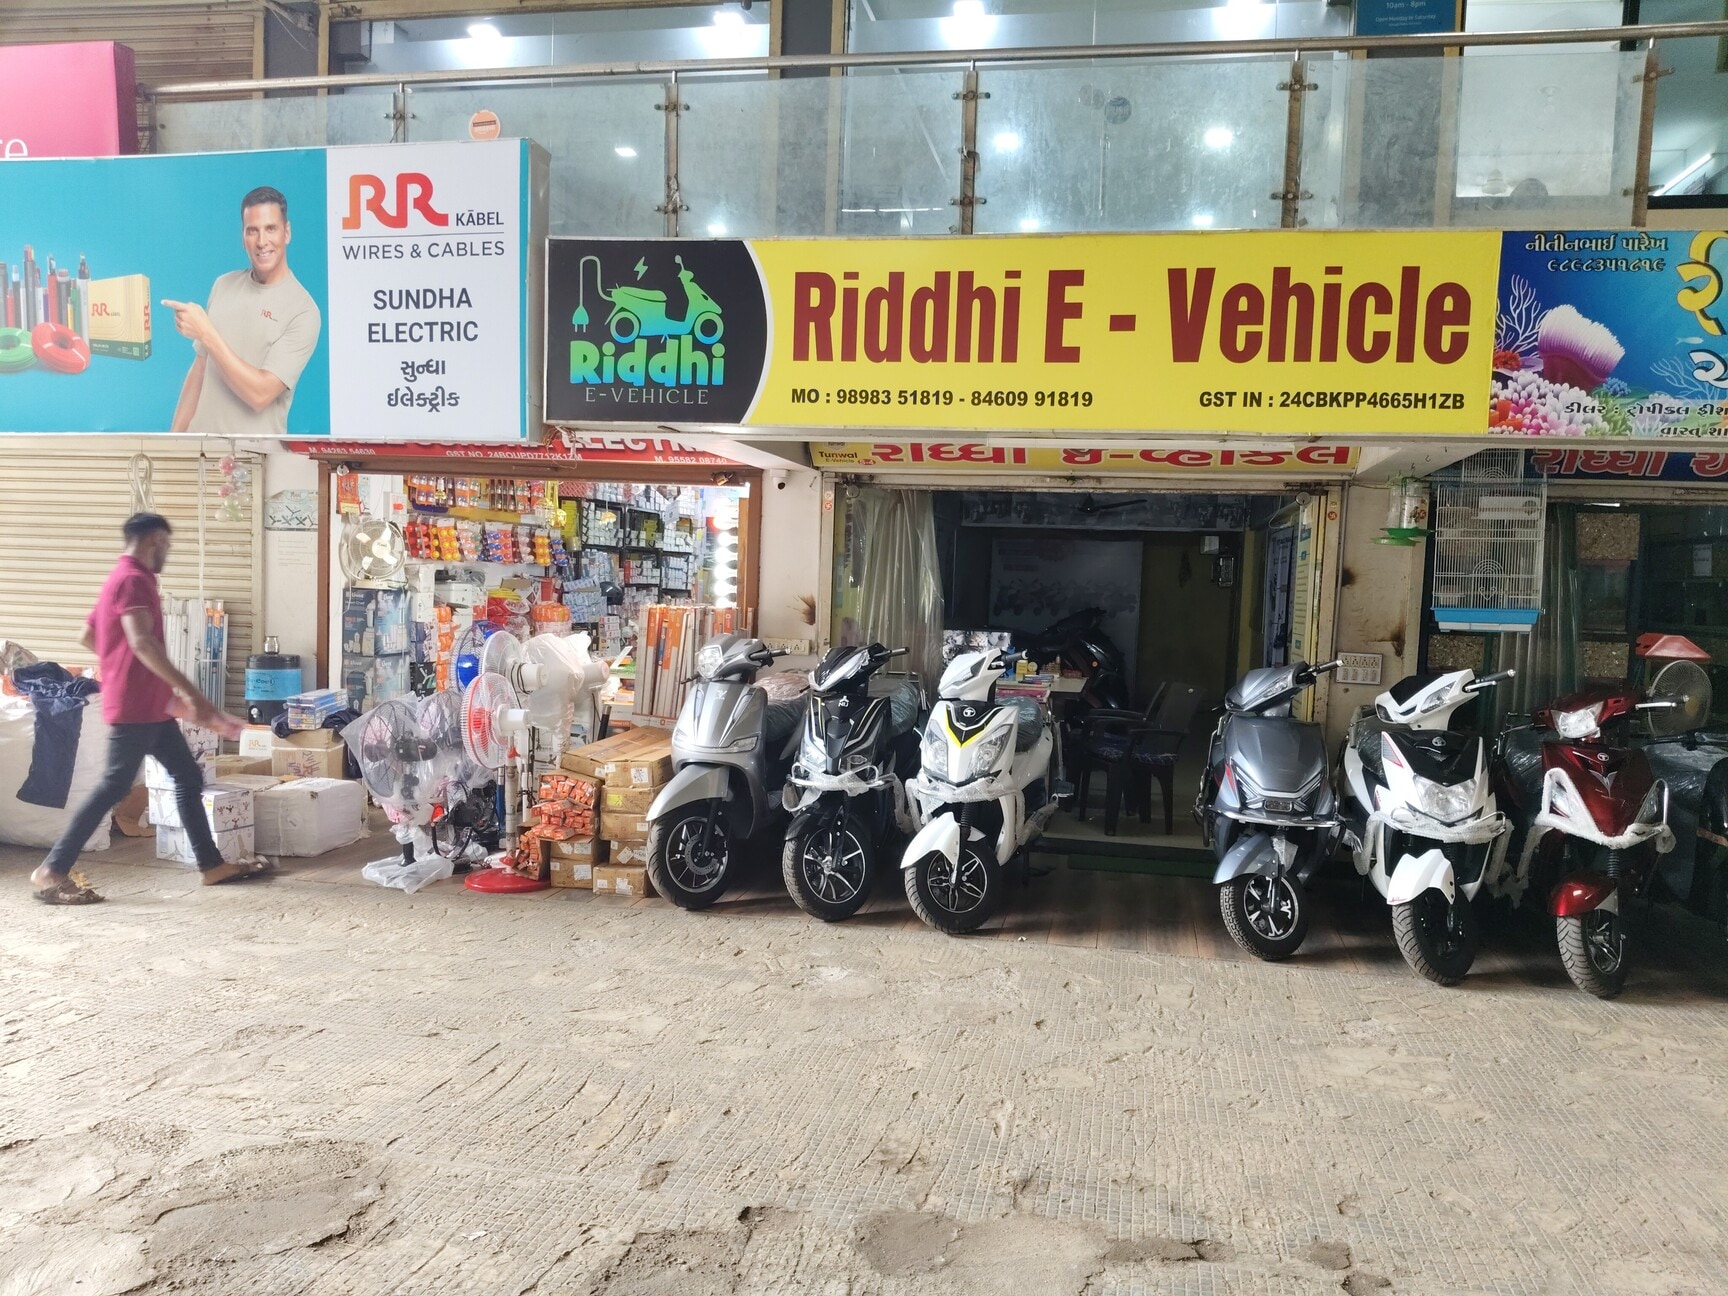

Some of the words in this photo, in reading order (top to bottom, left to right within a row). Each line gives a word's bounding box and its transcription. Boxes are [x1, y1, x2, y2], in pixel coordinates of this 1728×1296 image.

[342, 172, 449, 230] RR
[343, 245, 404, 260] WIRES
[410, 243, 422, 258] &
[427, 241, 505, 258] CABLES
[373, 287, 473, 310] SUNDHA
[91, 302, 110, 317] RR
[792, 270, 1021, 364] Riddhi
[1043, 269, 1085, 364] E
[1108, 314, 1137, 332] -
[1167, 266, 1473, 365] Vehicle
[367, 321, 479, 343] ELECTRIC
[570, 335, 726, 387] Riddhi
[585, 387, 709, 404] E-VEHICLE
[791, 388, 820, 404] MO
[836, 388, 892, 405] 98983
[897, 389, 954, 406] 51819
[970, 390, 1029, 407] 84609
[1034, 391, 1093, 407] 91819
[1199, 391, 1237, 408] GST
[1242, 391, 1263, 408] IN
[1279, 391, 1465, 410] 24CBKPP4665H1ZB
[818, 451, 858, 459] Tunwal
